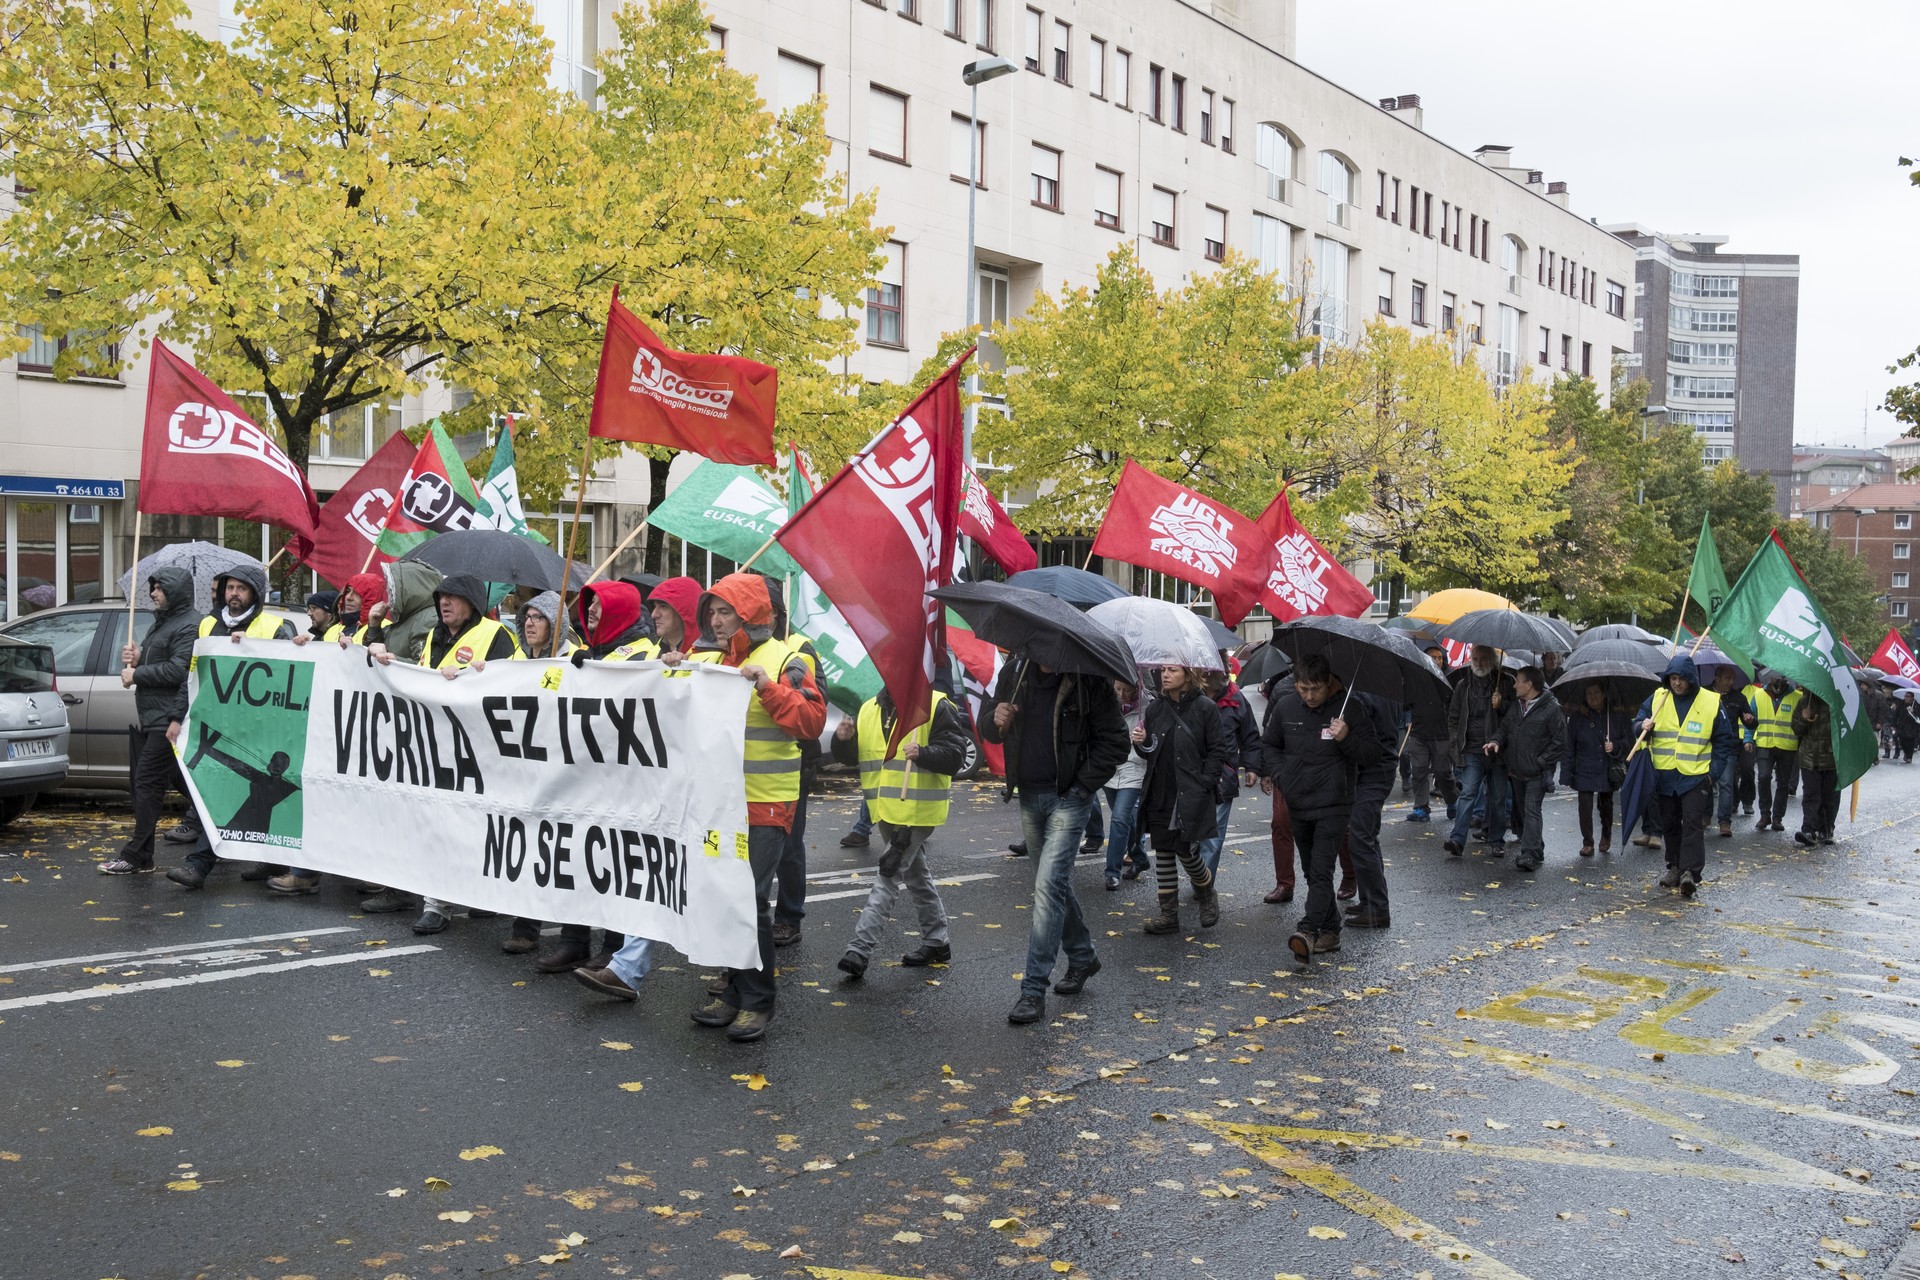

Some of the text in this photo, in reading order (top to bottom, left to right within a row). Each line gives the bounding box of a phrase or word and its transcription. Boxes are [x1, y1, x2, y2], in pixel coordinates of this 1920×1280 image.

[662, 396, 686, 409] langile
[688, 403, 728, 419] komisioak
[71, 485, 119, 496] 464 01 33
[703, 509, 764, 533] EUSKAL
[1170, 492, 1233, 539] UGT
[1150, 541, 1220, 578] EUSKADI
[1267, 578, 1307, 615] USKADI
[1758, 625, 1812, 658] EUSKAL
[334, 689, 668, 795] VICRILA EZ ITXI
[483, 813, 687, 916] NO SE CIERRA
[1465, 964, 1920, 1085] BUS
